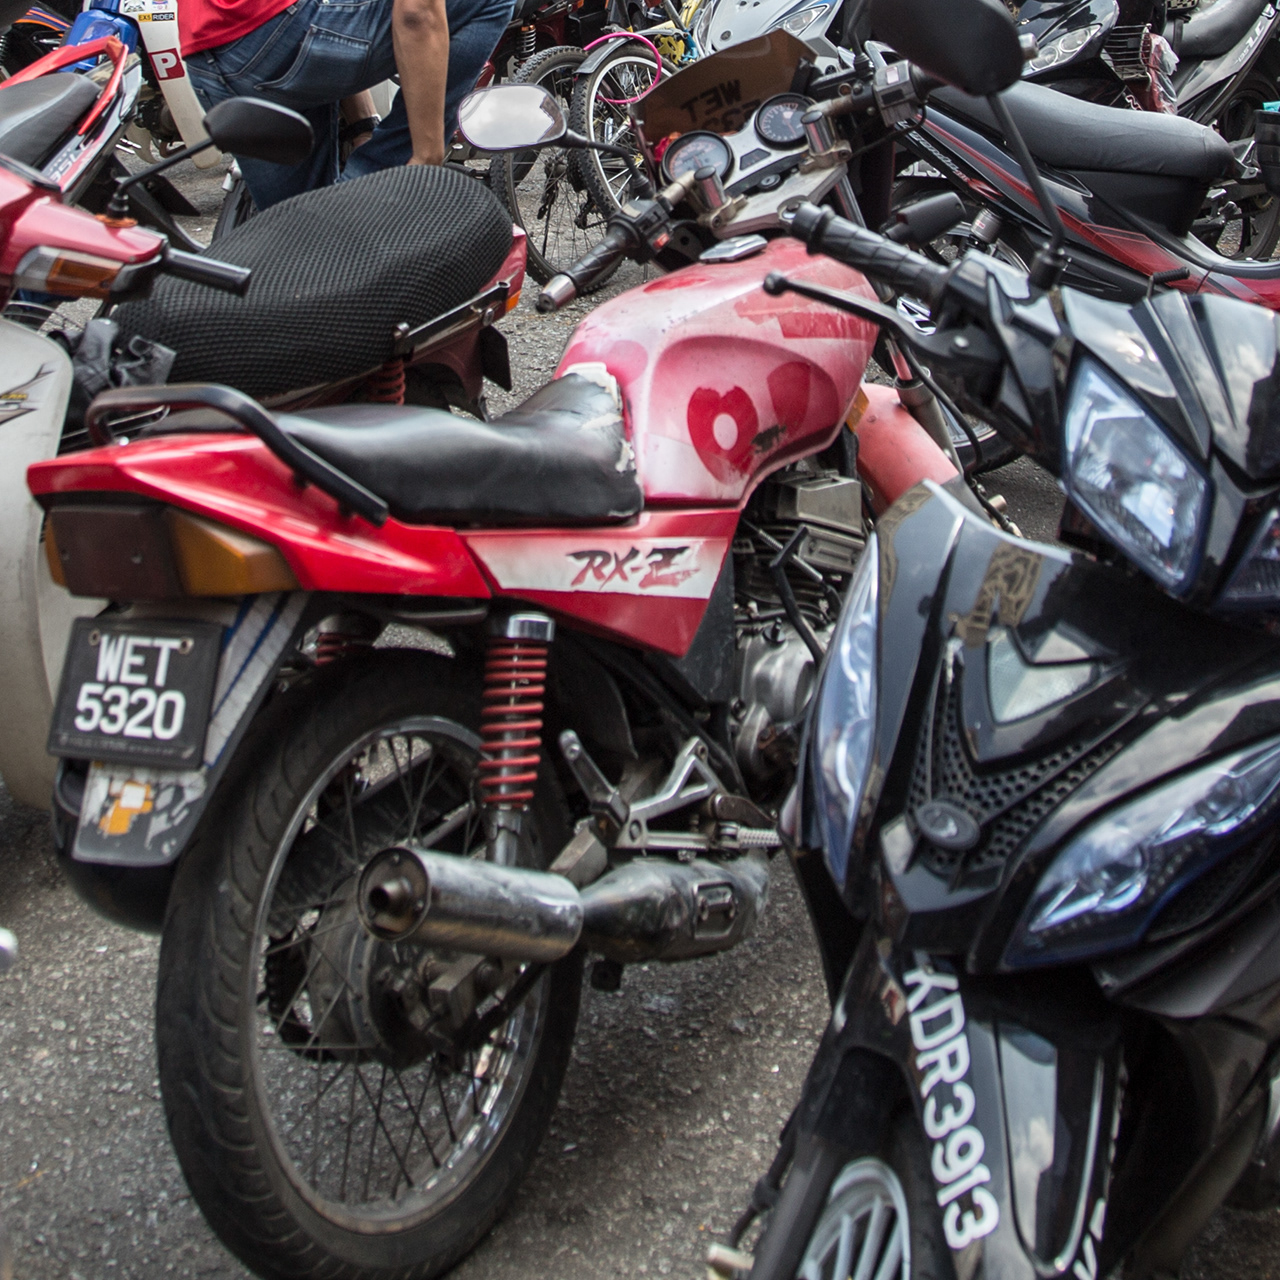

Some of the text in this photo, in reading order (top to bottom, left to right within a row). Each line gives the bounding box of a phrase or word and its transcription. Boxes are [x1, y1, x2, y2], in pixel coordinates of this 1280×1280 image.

[138, 13, 151, 21] EX5
[151, 52, 177, 78] P
[565, 546, 696, 590] RX-Z
[96, 634, 185, 687] WET
[74, 682, 186, 740] 5320
[903, 968, 999, 1250] KDR3913
